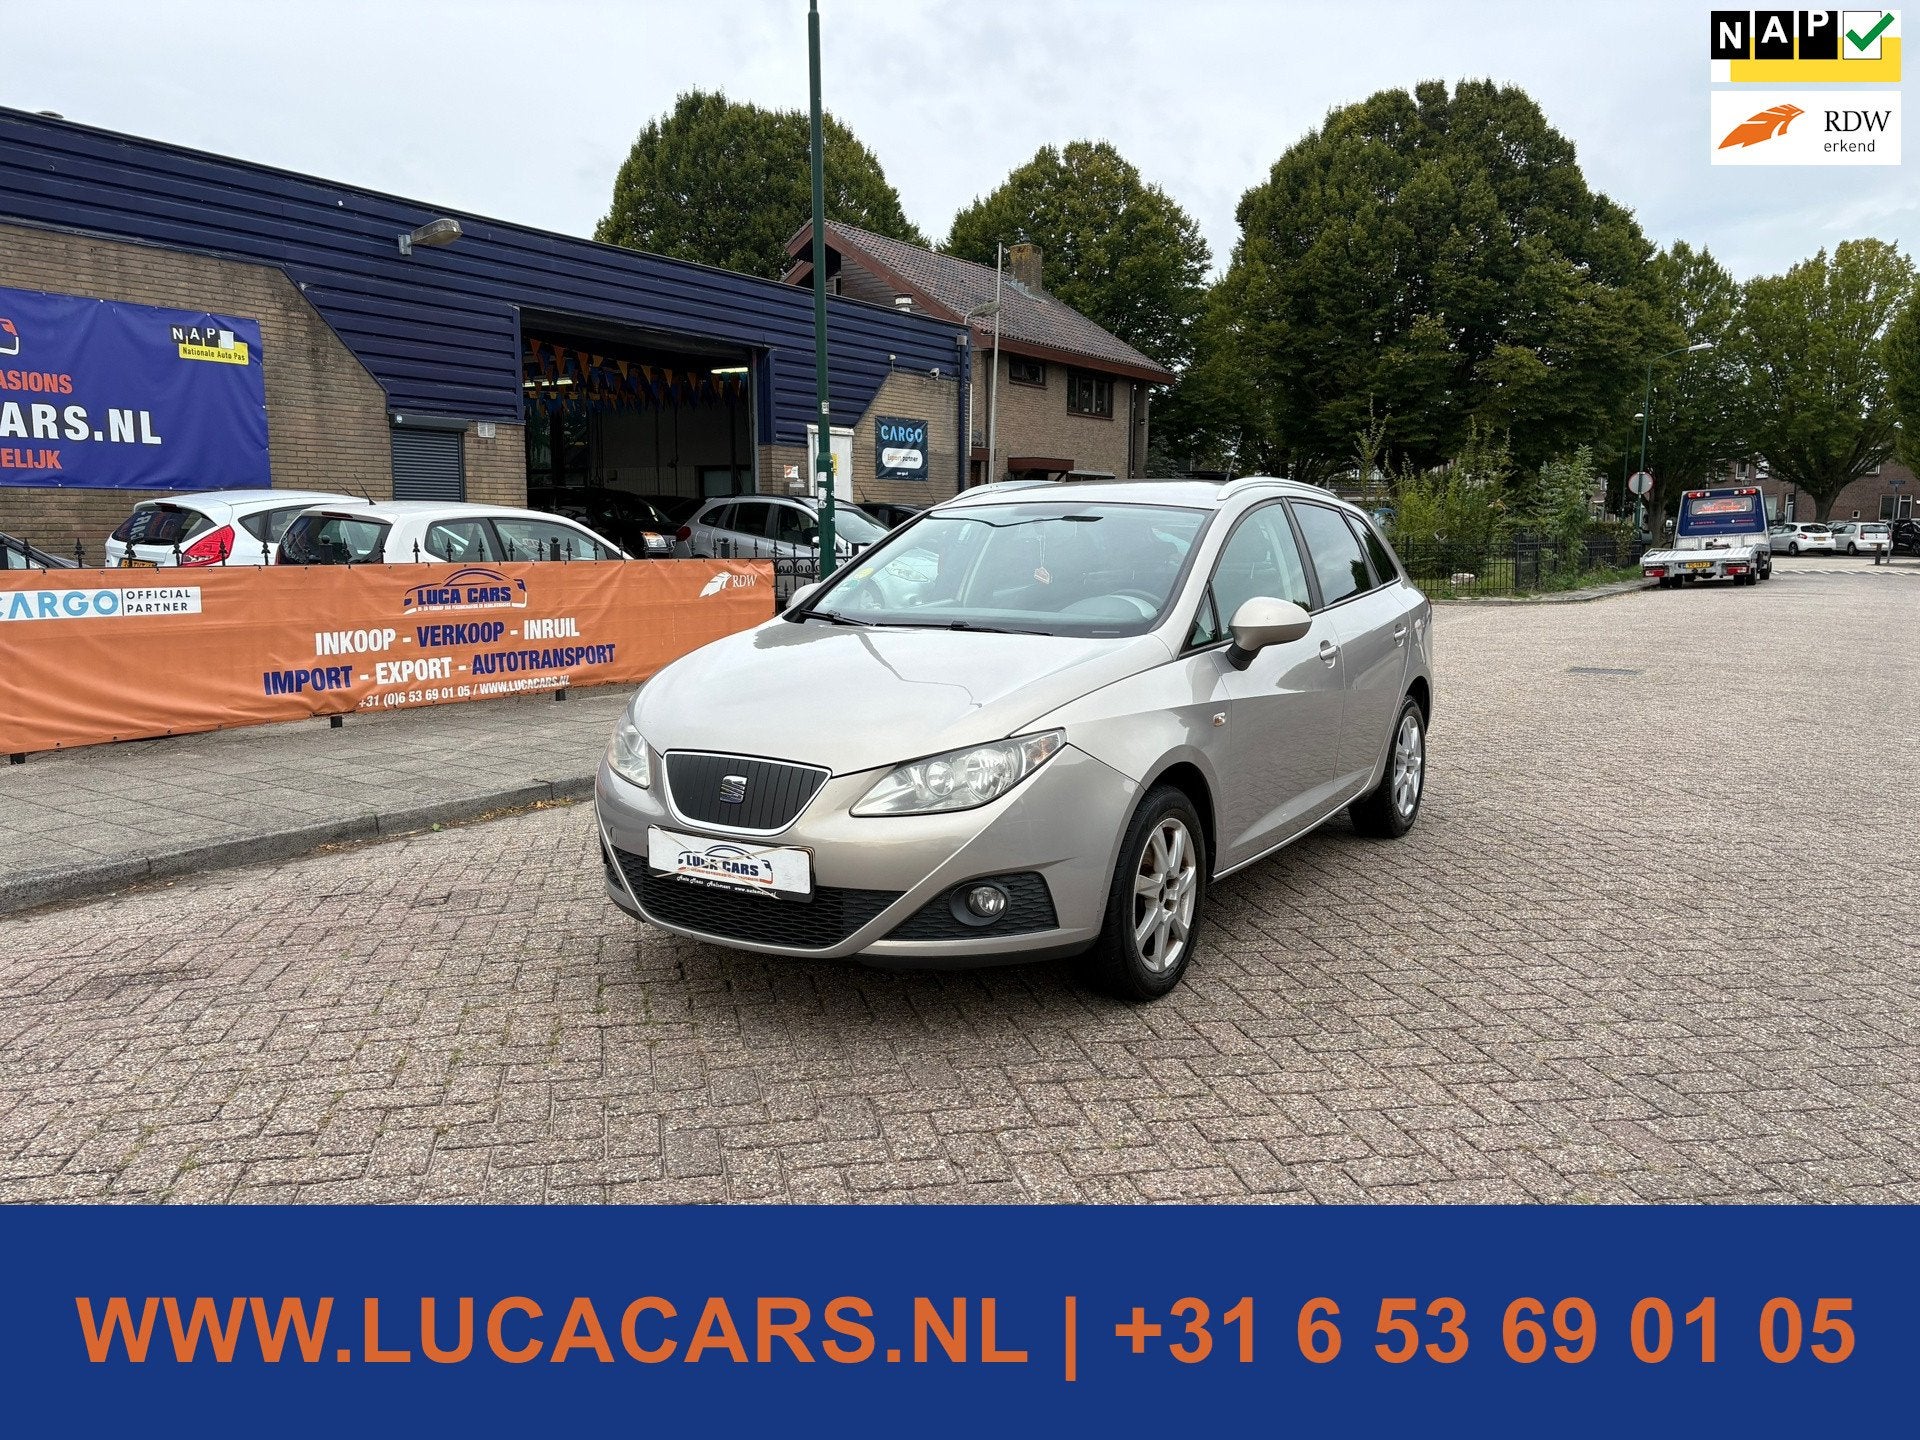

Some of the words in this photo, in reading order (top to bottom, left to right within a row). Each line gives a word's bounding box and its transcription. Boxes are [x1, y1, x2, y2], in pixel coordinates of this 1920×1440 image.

[172, 327, 216, 340] NAP
[182, 347, 215, 358] Nationale
[217, 351, 232, 359] Auto
[234, 352, 246, 361] Pas
[0, 402, 162, 445] ARS.NL
[881, 425, 923, 442] CARGO
[732, 574, 757, 588] RDW
[126, 589, 191, 600] OFFICIAL
[417, 588, 461, 605] LUCA
[467, 586, 511, 603] CARS
[0, 590, 119, 619] ARGO
[127, 602, 188, 613] PARTNER
[315, 628, 396, 656] INKOOP
[416, 621, 505, 648] VERKOOP
[523, 617, 580, 640] INRUIL
[263, 665, 353, 695] IMPORT
[375, 656, 452, 685] EXPORT
[472, 643, 616, 675] AUTOTRANSPORT
[359, 694, 379, 708] +31
[383, 691, 406, 707] (0)6
[408, 690, 422, 703] 53
[425, 688, 439, 701] 69
[441, 687, 454, 699] 01
[457, 685, 470, 697] 05
[479, 675, 570, 695] WWW.LUCACARS.NL
[722, 860, 759, 876] CARS
